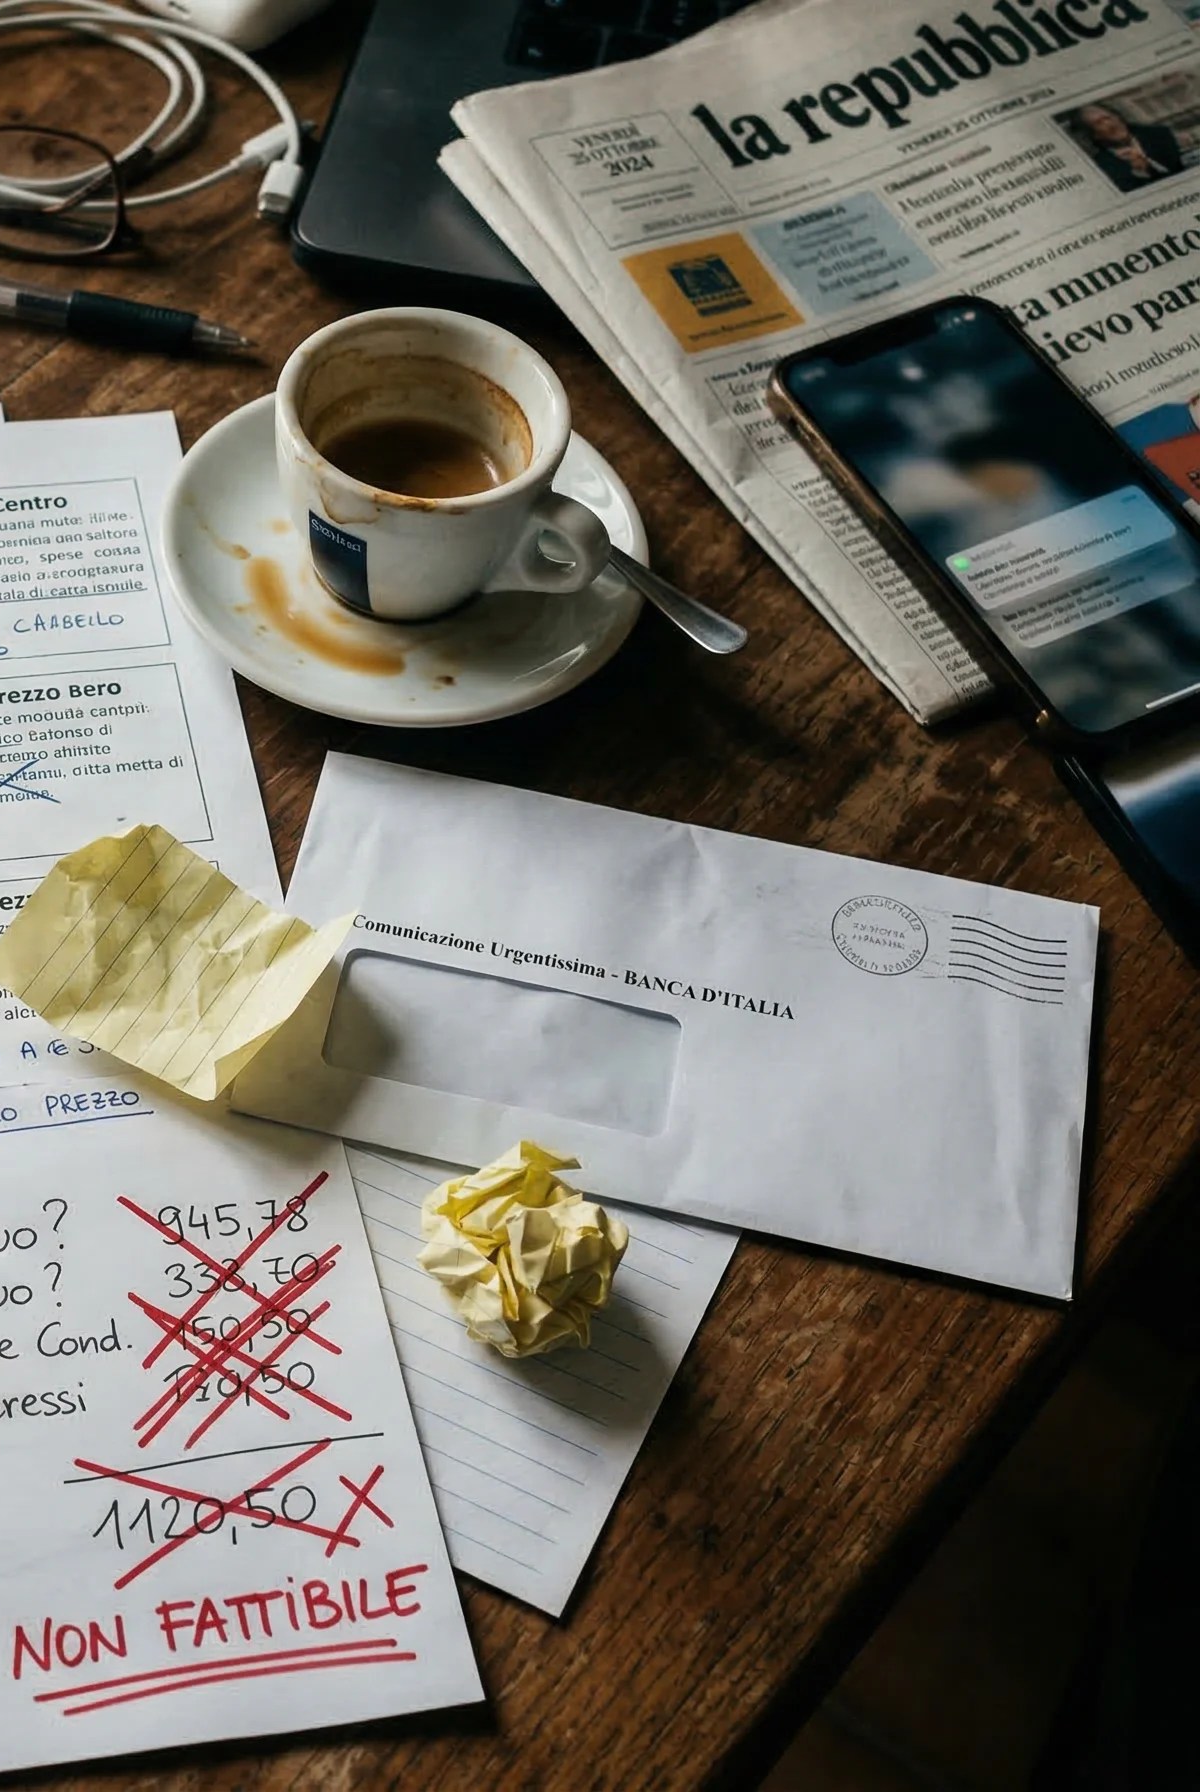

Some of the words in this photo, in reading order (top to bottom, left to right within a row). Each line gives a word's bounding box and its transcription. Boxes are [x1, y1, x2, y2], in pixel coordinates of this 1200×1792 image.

[691, 103, 791, 168] la
[783, 0, 1149, 144] repubblica
[604, 156, 654, 177] 2024
[39, 550, 84, 564] spese
[69, 681, 122, 698] Bero
[99, 723, 113, 736] di
[116, 759, 163, 773] metta
[168, 755, 184, 768] di
[352, 913, 486, 955] Comunicazione
[490, 940, 607, 981] Urgentissima
[623, 969, 698, 1001] BANCA
[700, 986, 795, 1021] D'ITALIA
[45, 1090, 140, 1117] PREZZO
[157, 1195, 309, 1245] 945,78
[35, 1317, 134, 1358] Cond.
[177, 1308, 312, 1354] 150,50
[91, 1483, 317, 1551] 1120,50
[13, 1614, 128, 1681] NON
